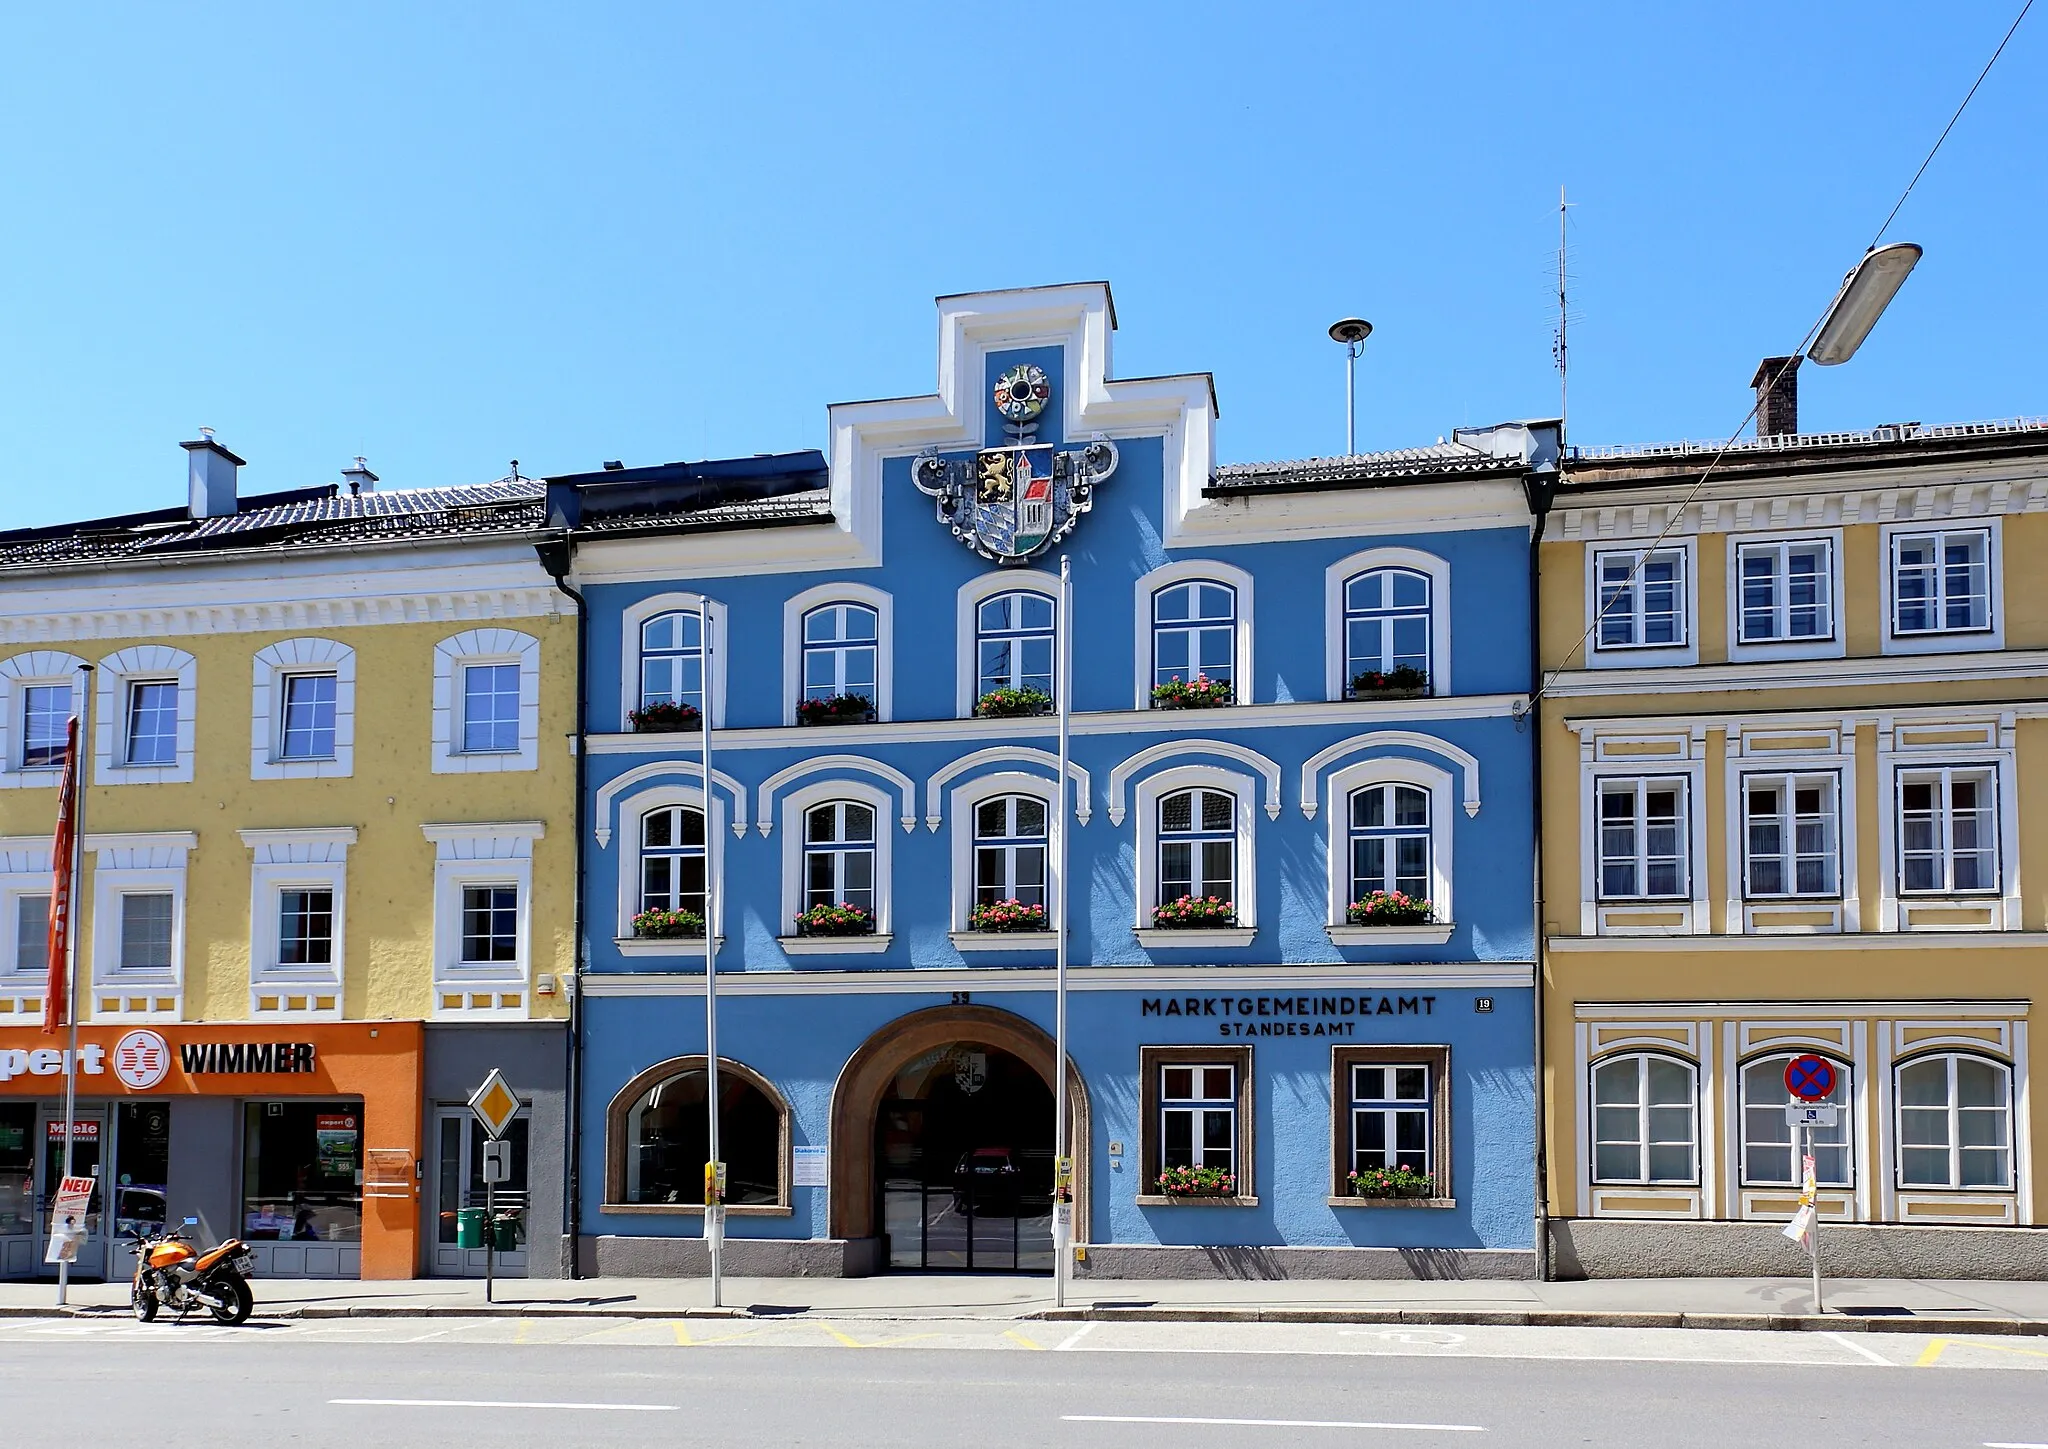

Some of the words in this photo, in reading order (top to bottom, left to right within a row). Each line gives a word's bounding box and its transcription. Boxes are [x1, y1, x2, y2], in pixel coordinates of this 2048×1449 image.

[952, 991, 970, 1004] 59
[1479, 1000, 1490, 1008] 19
[1142, 996, 1436, 1016] MARKTGEMEINDEAMT
[1220, 1022, 1355, 1036] STANDESAMT
[180, 1043, 316, 1073] WIMMER
[50, 1123, 98, 1134] Mele
[62, 1178, 93, 1193] NEU
